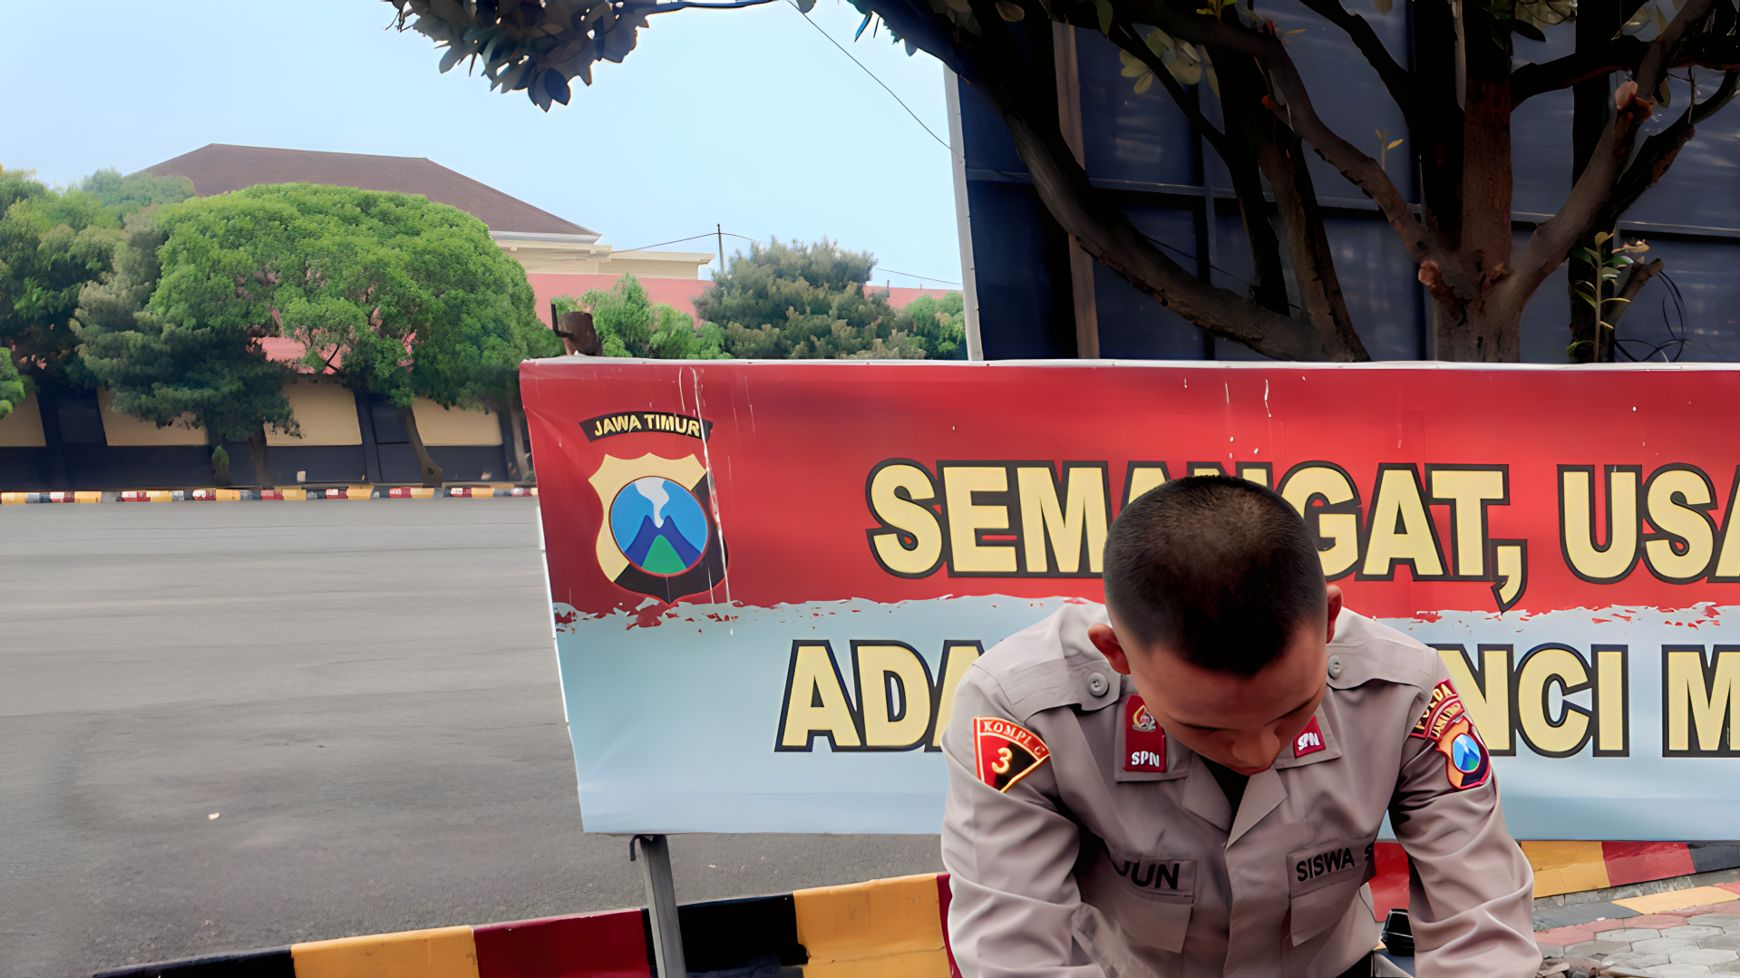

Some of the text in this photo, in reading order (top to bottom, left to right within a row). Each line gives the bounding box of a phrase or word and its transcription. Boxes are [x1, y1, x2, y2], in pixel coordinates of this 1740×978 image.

[594, 414, 700, 437] JAWA TIMUR
[866, 458, 1527, 612] SEMGAT,
[1427, 642, 1630, 758] NCI
[1298, 732, 1321, 751] SPN
[991, 747, 1013, 774] 3
[1131, 751, 1160, 768] SPN
[1296, 847, 1356, 882] SISWA
